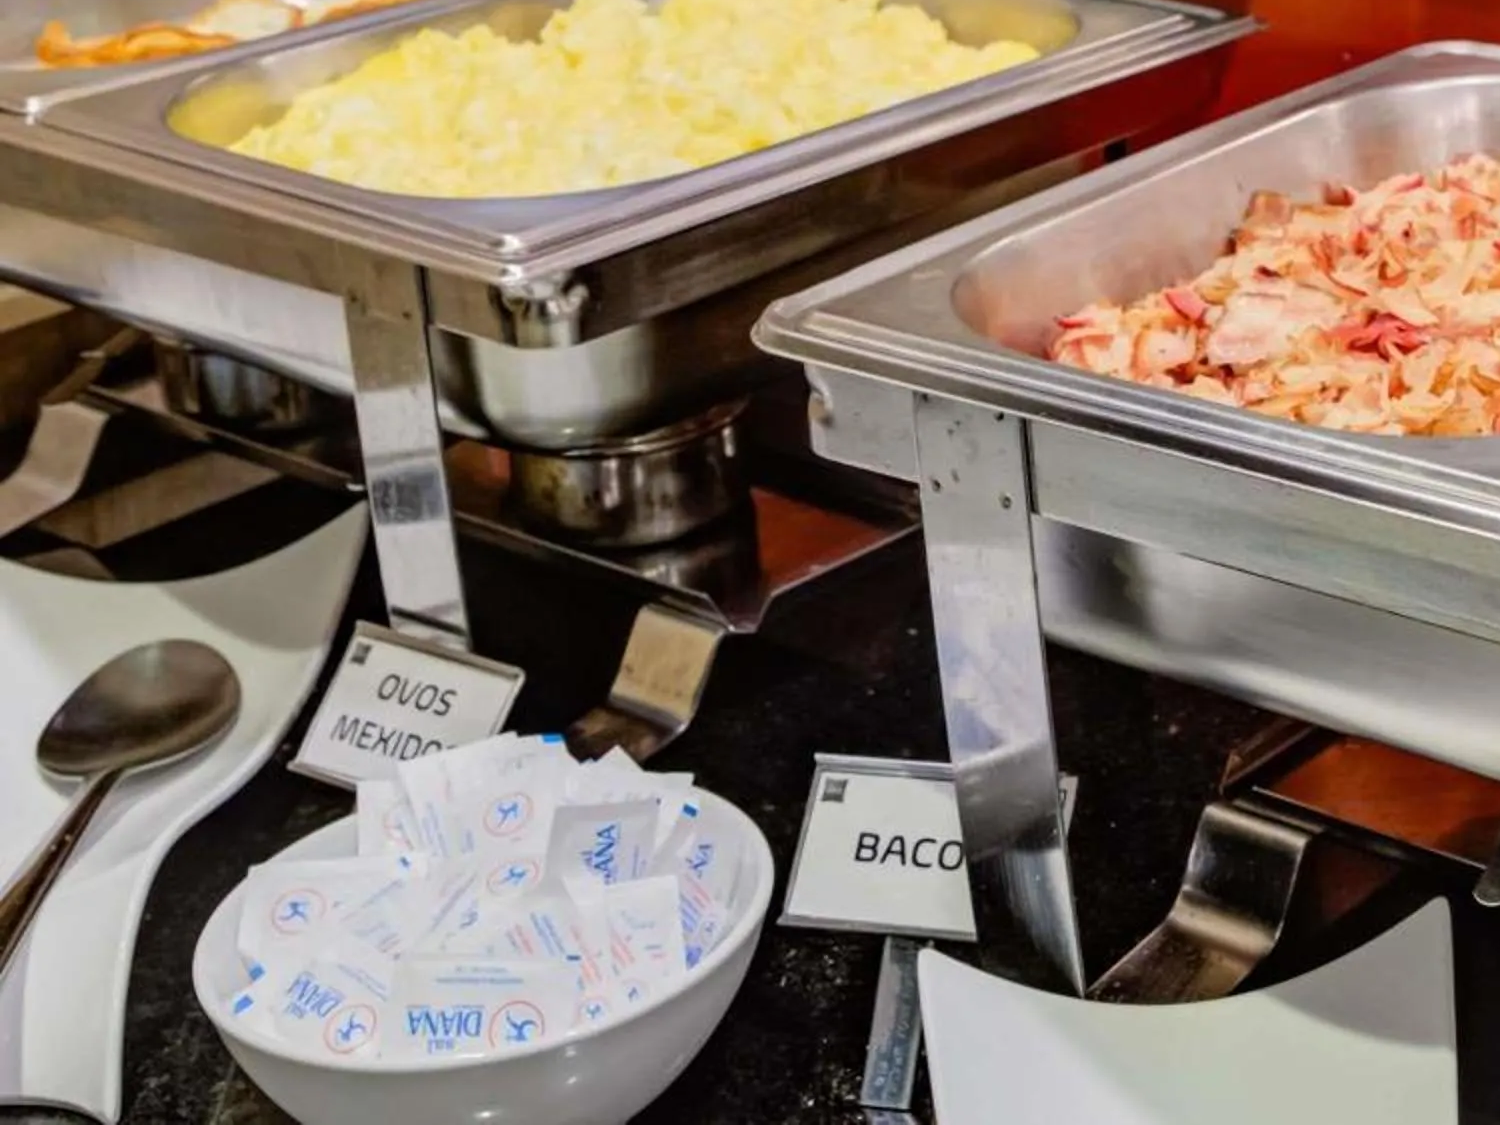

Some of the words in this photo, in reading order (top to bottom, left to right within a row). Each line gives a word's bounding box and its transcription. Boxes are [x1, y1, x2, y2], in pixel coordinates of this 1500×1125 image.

[377, 673, 457, 717] OVOS
[330, 714, 457, 761] MEXIDO
[854, 831, 964, 871] BACO
[407, 1009, 483, 1037] DIANA
